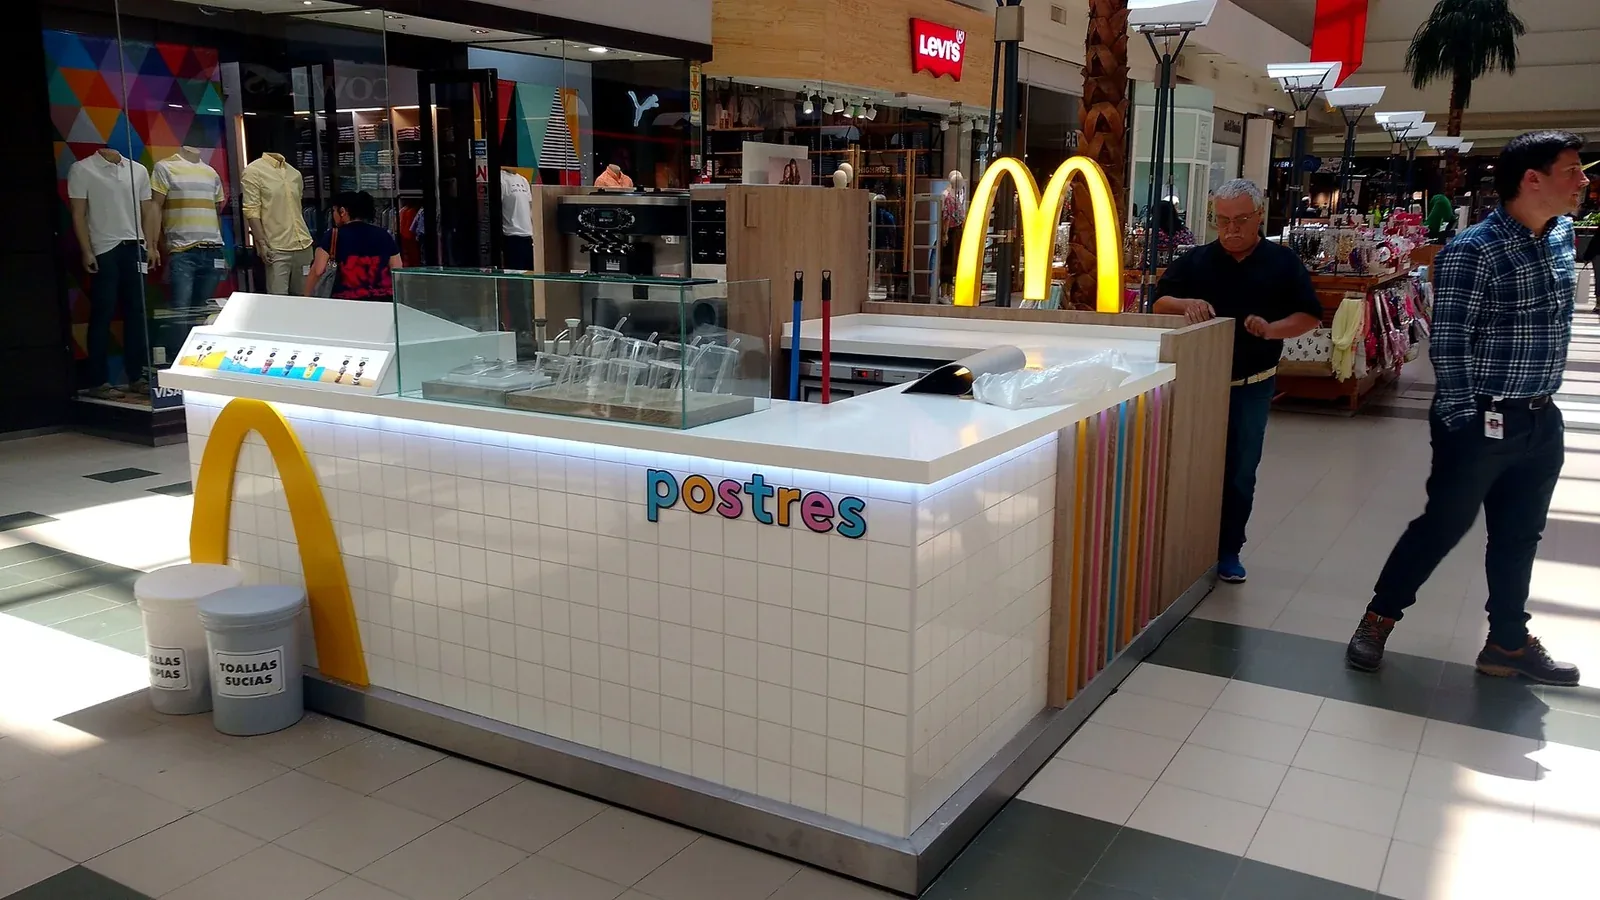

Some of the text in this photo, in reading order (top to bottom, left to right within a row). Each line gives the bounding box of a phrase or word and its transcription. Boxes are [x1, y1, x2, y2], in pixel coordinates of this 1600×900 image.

[152, 387, 183, 398] VISA
[646, 468, 867, 539] postres
[150, 655, 181, 666] ALLAS
[219, 659, 278, 673] TOALLAS
[149, 669, 181, 679] PIAS
[225, 674, 272, 687] SUCIAS
